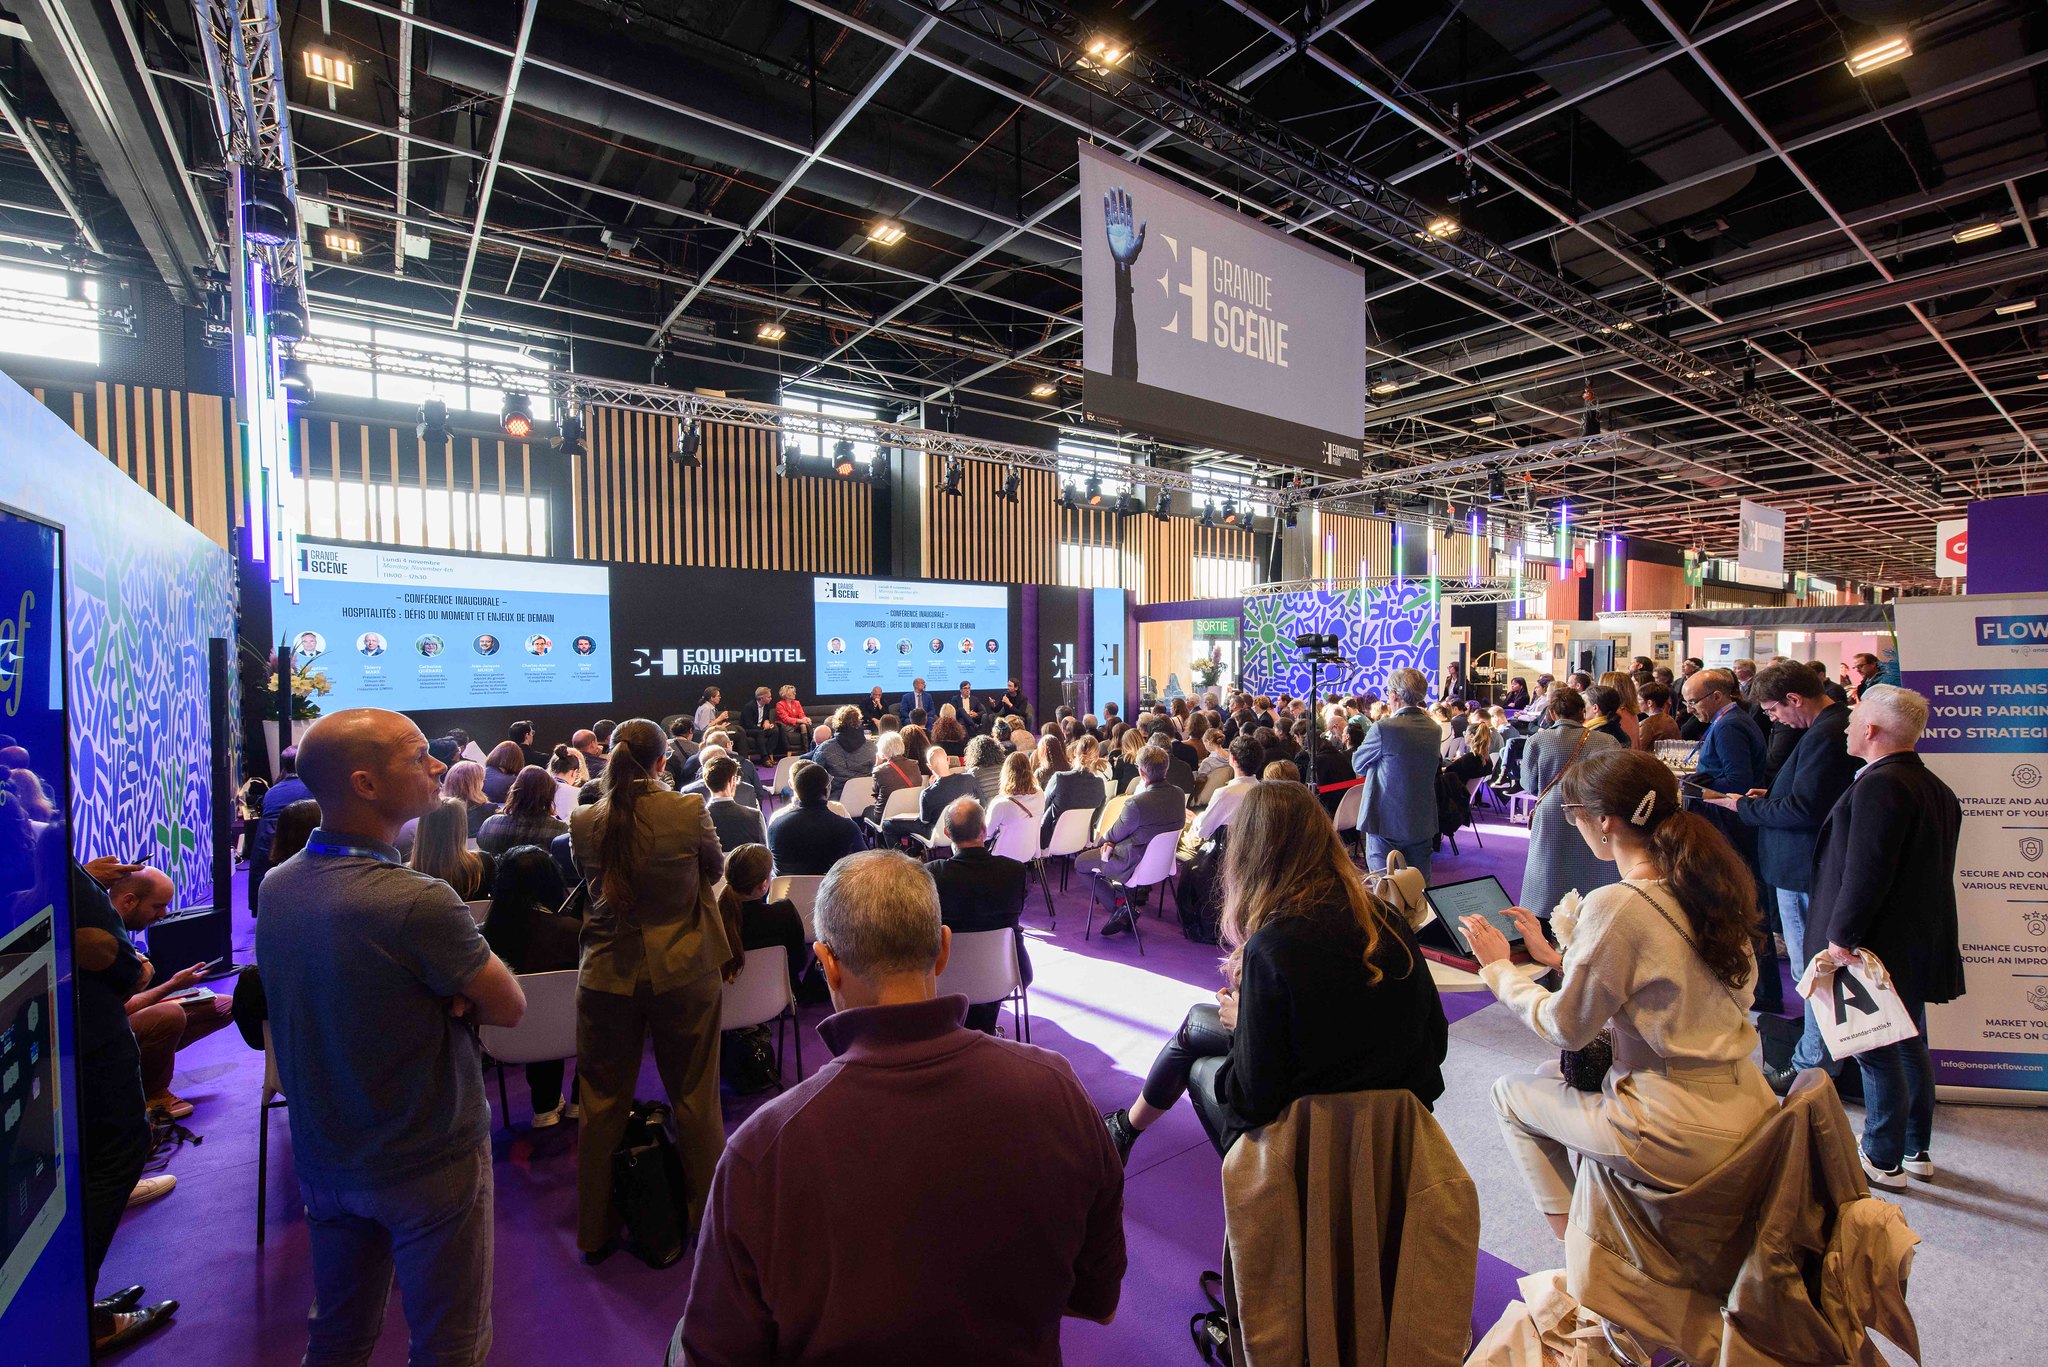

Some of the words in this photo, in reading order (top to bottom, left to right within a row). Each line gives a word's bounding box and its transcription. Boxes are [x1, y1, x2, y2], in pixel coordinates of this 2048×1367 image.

[1213, 256, 1272, 312] GRANDE
[98, 308, 124, 318] S1A
[208, 324, 232, 334] S2A
[1214, 300, 1288, 367] SCÈNE
[310, 549, 339, 562] GRANDE
[411, 564, 442, 572] November
[404, 592, 453, 605] CONFÉRENCE
[455, 595, 500, 606] INAUGURALE
[342, 606, 397, 619] HOSPITALITÉS
[404, 608, 426, 620] DÉFIS
[428, 610, 439, 620] DU
[440, 610, 474, 620] MOMENT
[477, 611, 485, 621] ET
[487, 612, 515, 622] ENJEUX
[516, 613, 525, 622] DE
[527, 613, 555, 623] DEMAIN
[890, 609, 918, 618] CONFÉRENCE
[919, 610, 944, 618] INAUGURALE
[855, 620, 886, 628] HOSPITALITÉS
[890, 620, 903, 628] DÉFIS
[911, 621, 930, 629] MOMENT
[960, 622, 976, 630] DEMAIN
[1197, 620, 1228, 632] SORTIE
[1982, 622, 2048, 639] FLOW
[683, 648, 806, 664] EQUIPHOTEL
[683, 664, 721, 675] PARIS
[1934, 684, 1986, 696] FLOW
[1989, 683, 2048, 695] TRANS
[1933, 706, 1982, 717] YOUR
[1987, 705, 2048, 717] PARKIN
[1920, 728, 1962, 739] INTO
[1966, 727, 2048, 739] STRATEGI
[1960, 870, 1999, 878] SECURE
[1962, 882, 2007, 890] VARIOUS
[1962, 943, 2011, 952] ENHANCE
[1833, 965, 1880, 1026] A
[1985, 1019, 2028, 1028] MARKET
[1982, 1031, 2021, 1040] SPACES
[2024, 1032, 2039, 1040] ON
[1940, 1060, 2044, 1072] info@oneparkflow.com
